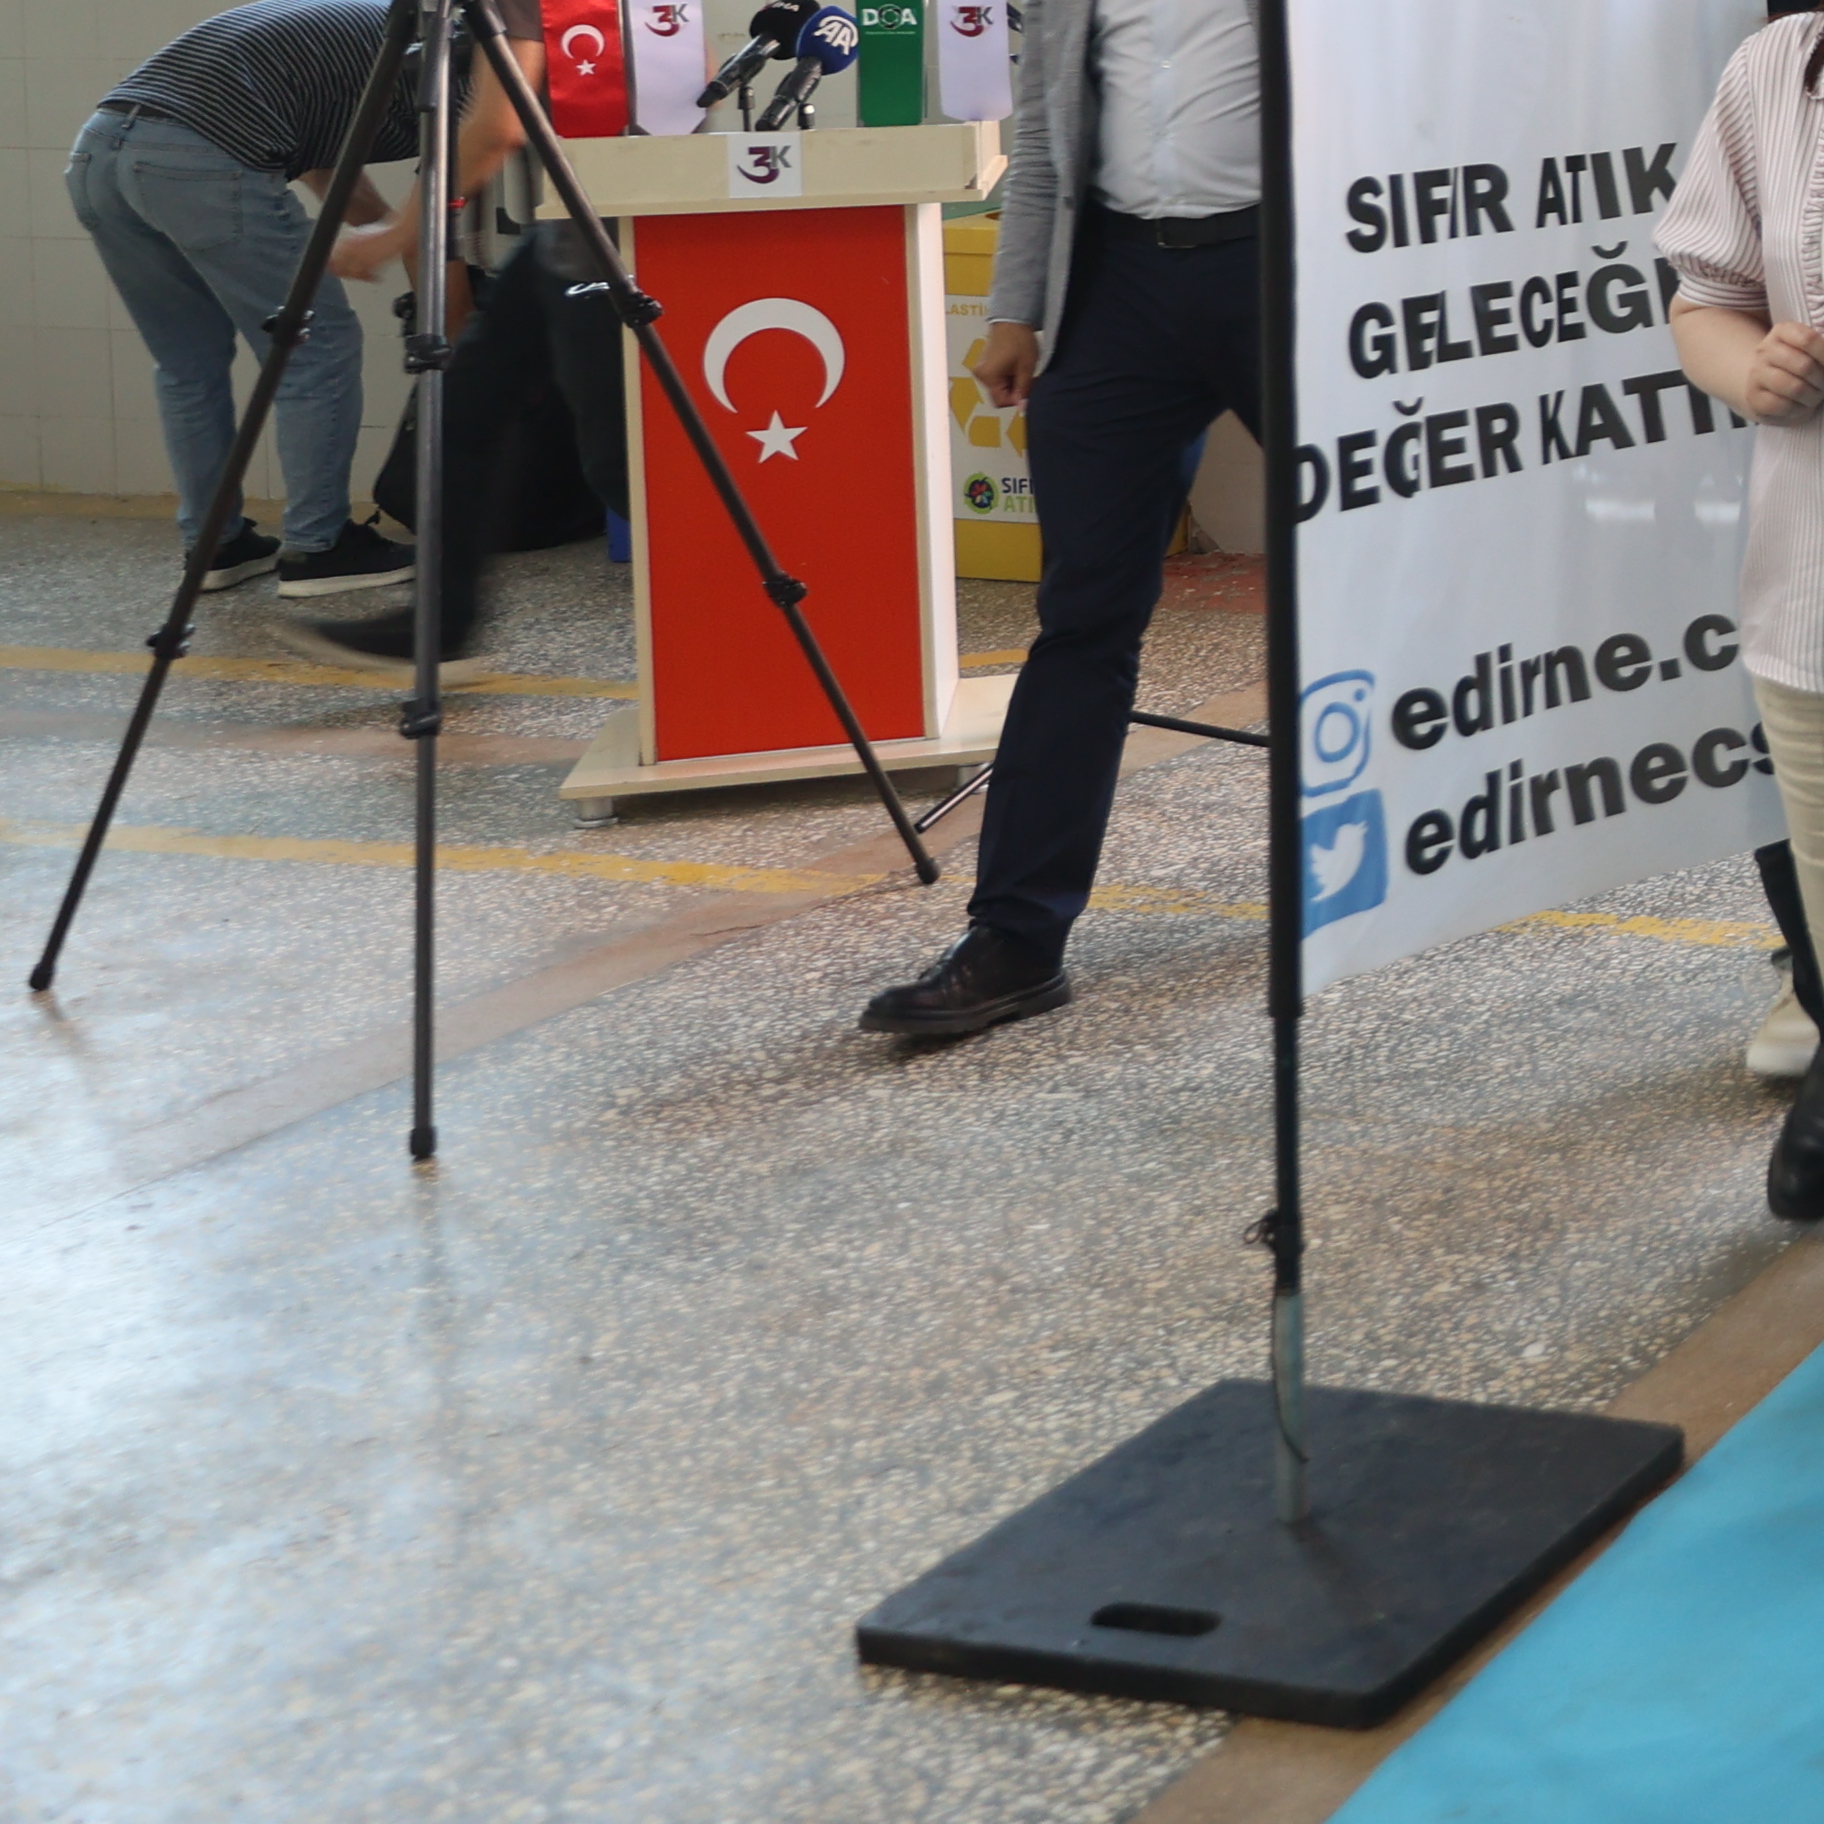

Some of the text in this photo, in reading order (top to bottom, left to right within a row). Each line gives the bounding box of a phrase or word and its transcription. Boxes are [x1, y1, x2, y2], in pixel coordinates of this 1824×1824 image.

[644, 3, 690, 37] 3K
[950, 5, 993, 37] 3K
[736, 144, 792, 184] 3K
[1345, 141, 1678, 254] SIFIR ATIK
[1294, 396, 1523, 524] DEĞER
